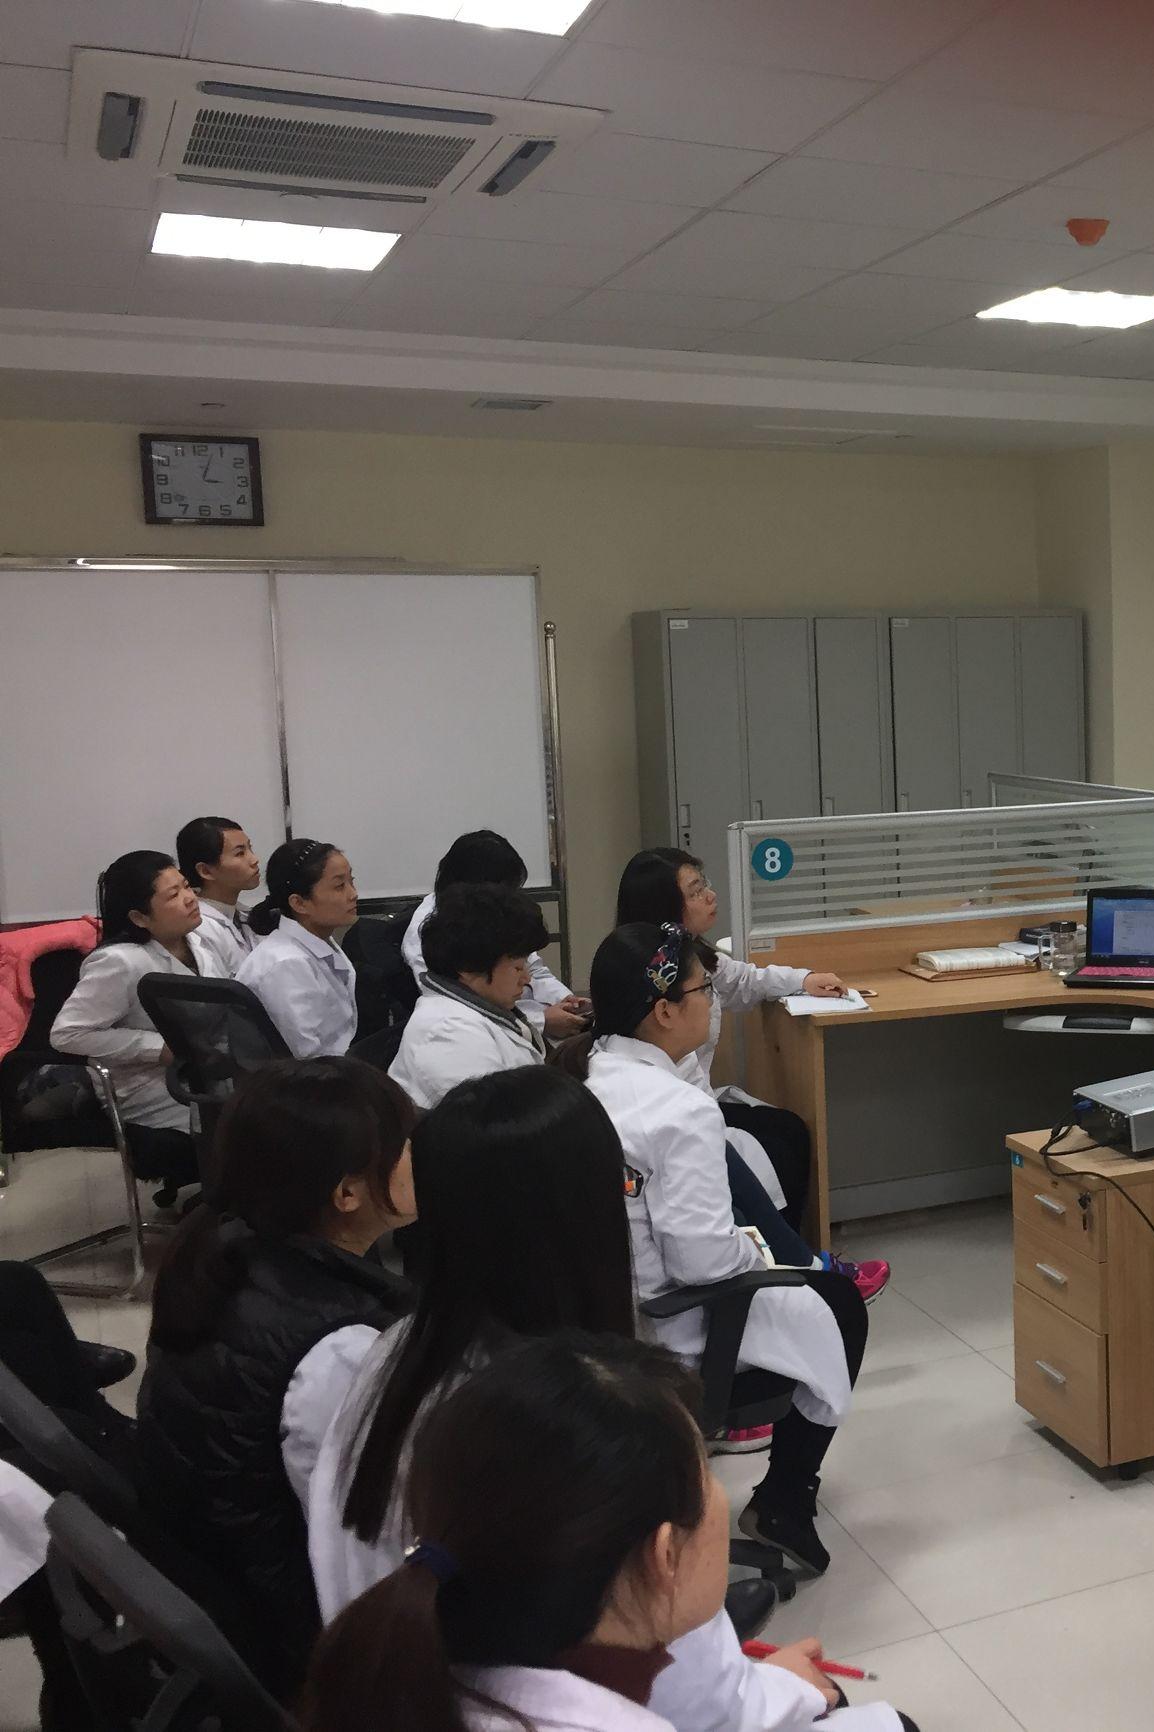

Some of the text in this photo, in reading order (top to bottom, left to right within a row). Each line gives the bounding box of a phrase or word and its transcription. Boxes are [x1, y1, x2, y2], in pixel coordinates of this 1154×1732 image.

[192, 445, 209, 457] 12
[219, 447, 225, 458] 1
[233, 457, 245, 469] 2
[156, 474, 169, 486] 9
[237, 475, 249, 488] 3
[160, 492, 172, 505] 8
[236, 494, 247, 506] 4
[178, 504, 189, 516] 7
[198, 505, 212, 517] 6
[219, 504, 233, 517] 5
[764, 846, 782, 874] 8
